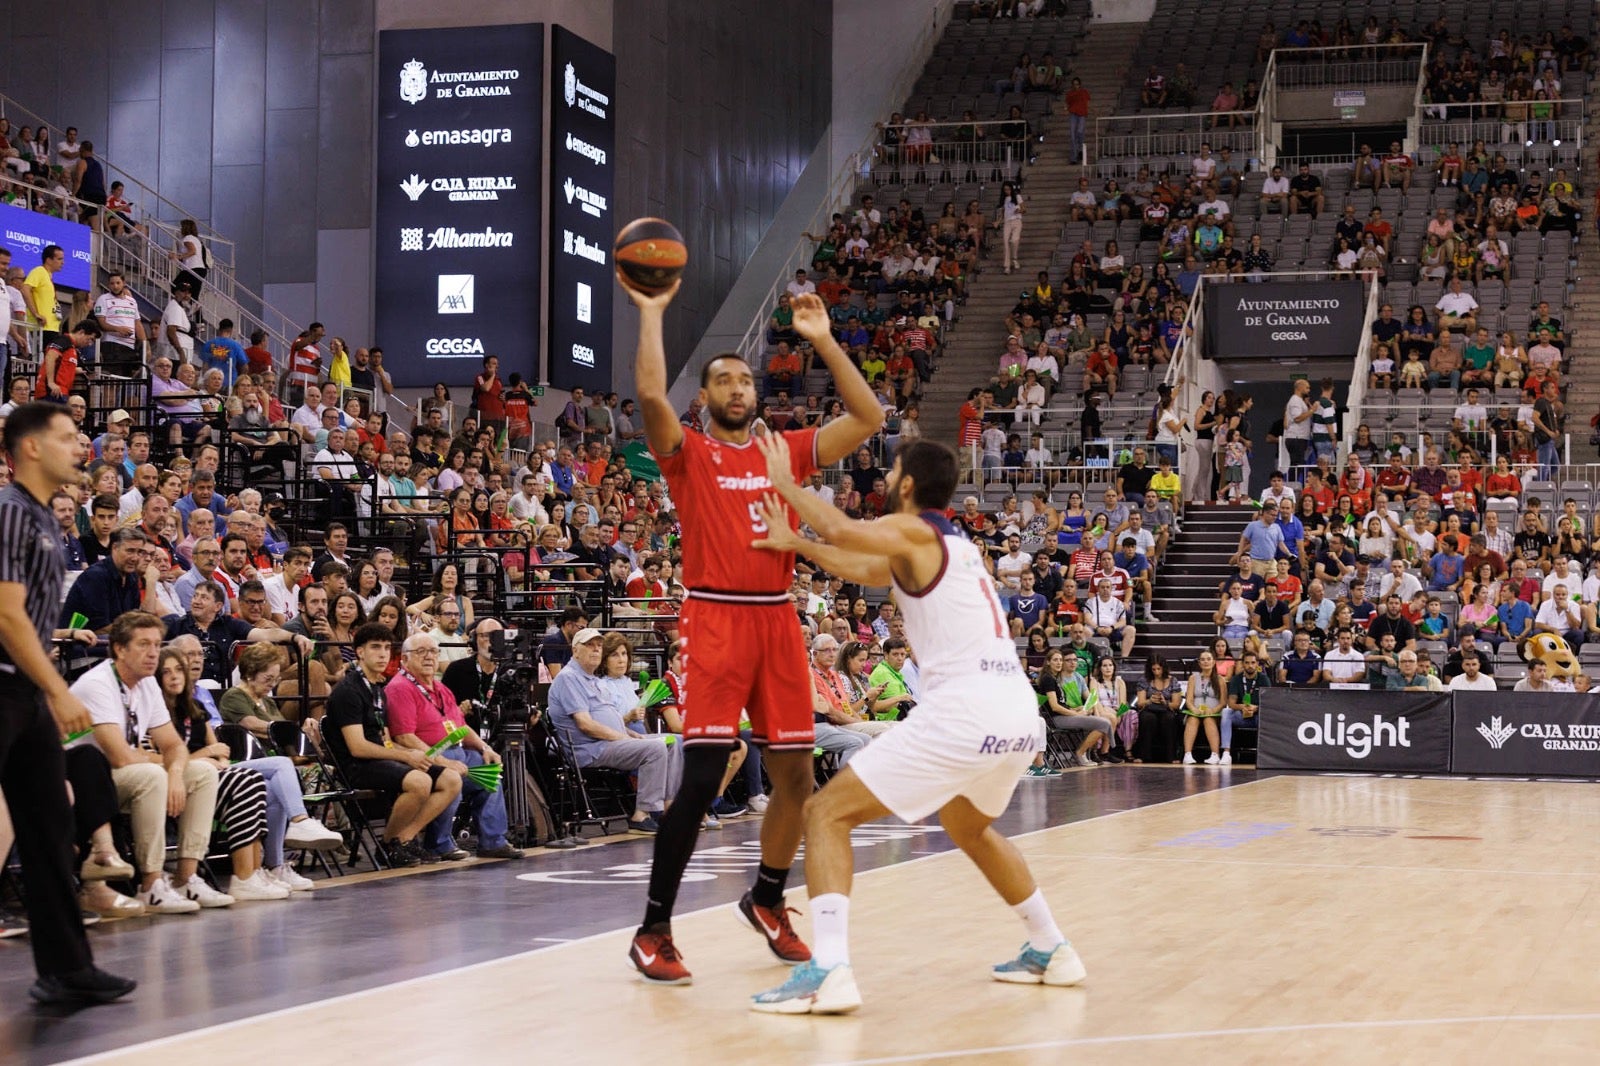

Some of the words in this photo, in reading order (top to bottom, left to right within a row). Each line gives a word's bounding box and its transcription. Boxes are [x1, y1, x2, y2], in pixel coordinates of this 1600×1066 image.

[430, 70, 519, 83] AYUNTAMIENTO
[437, 88, 452, 98] DE
[455, 84, 511, 97] GRANADA
[422, 128, 512, 147] emasagra
[431, 178, 465, 191] CAJA
[467, 177, 516, 190] RURAL
[448, 191, 499, 201] GRANADA
[426, 227, 513, 251] Alhambra
[439, 295, 467, 309] AXA
[1237, 298, 1340, 310] AYUNTAMIENTO
[1245, 317, 1262, 326] DE
[1266, 312, 1330, 326] GRANADA
[1297, 713, 1411, 759] alight
[1520, 723, 1565, 739] CAJA
